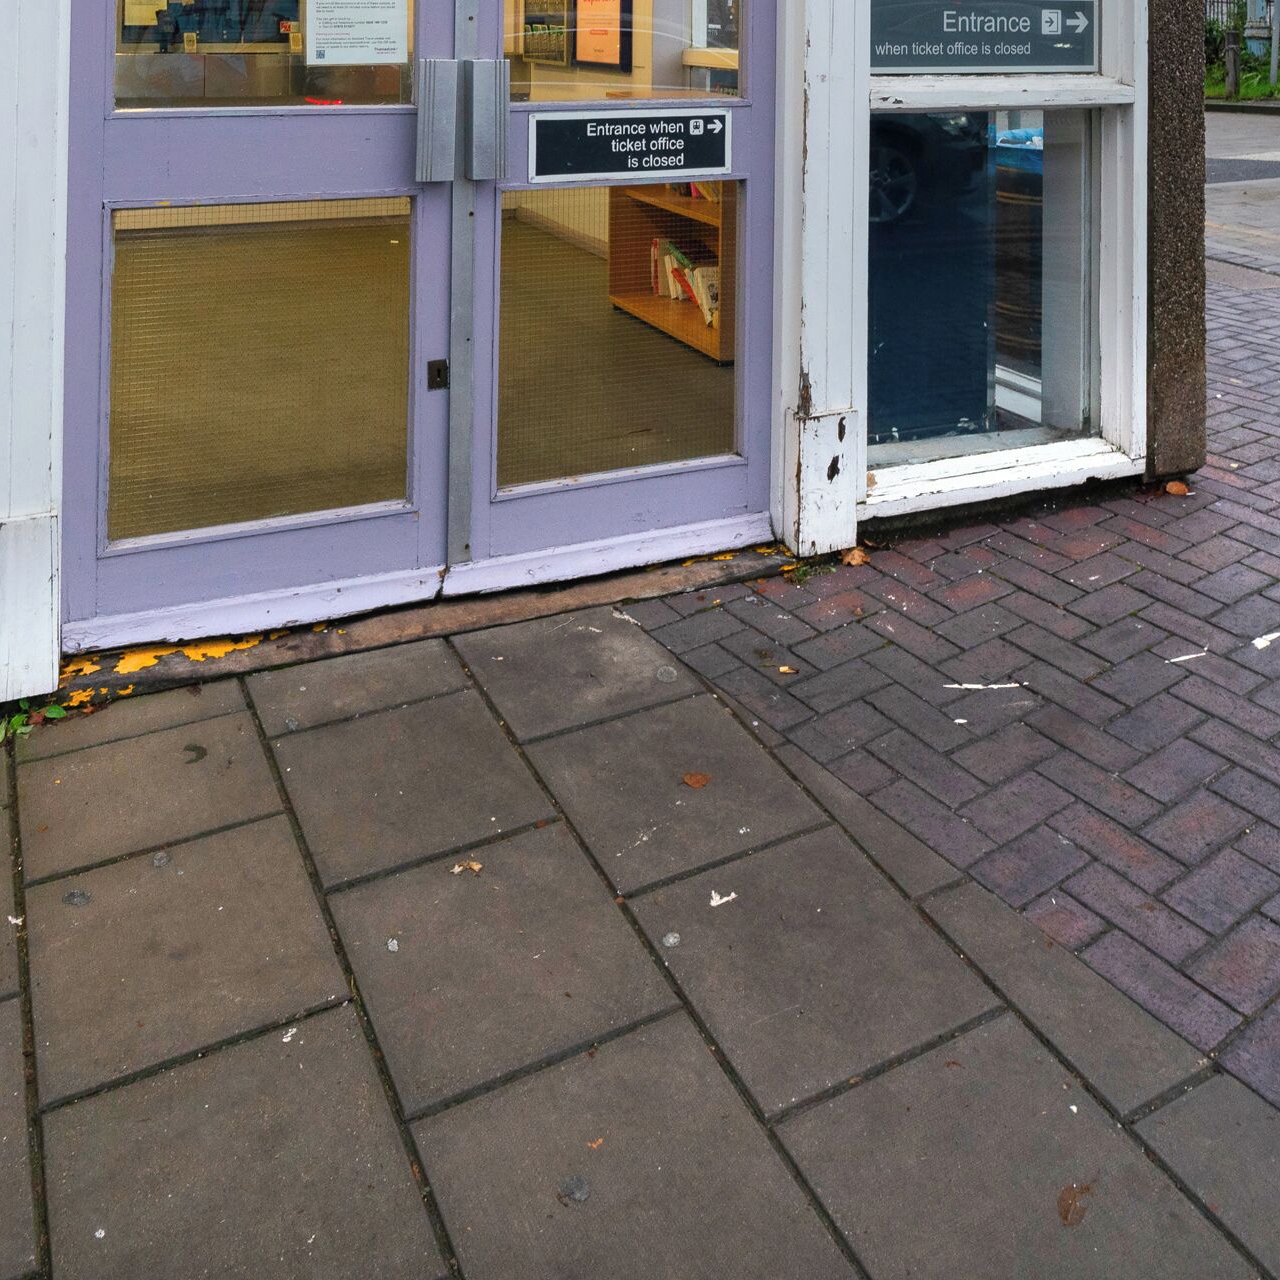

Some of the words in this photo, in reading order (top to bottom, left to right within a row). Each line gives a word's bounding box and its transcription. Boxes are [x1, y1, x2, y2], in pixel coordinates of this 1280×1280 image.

[943, 10, 1031, 33] Entrance
[875, 42, 908, 55] when
[912, 42, 944, 55] ticket
[947, 42, 978, 55] office
[981, 42, 991, 55] is
[994, 42, 1031, 55] closed
[587, 122, 646, 137] Entrance
[649, 121, 684, 134] when
[611, 138, 646, 152] ticket
[650, 137, 684, 150] office
[627, 156, 639, 168] is
[642, 153, 684, 167] closed
